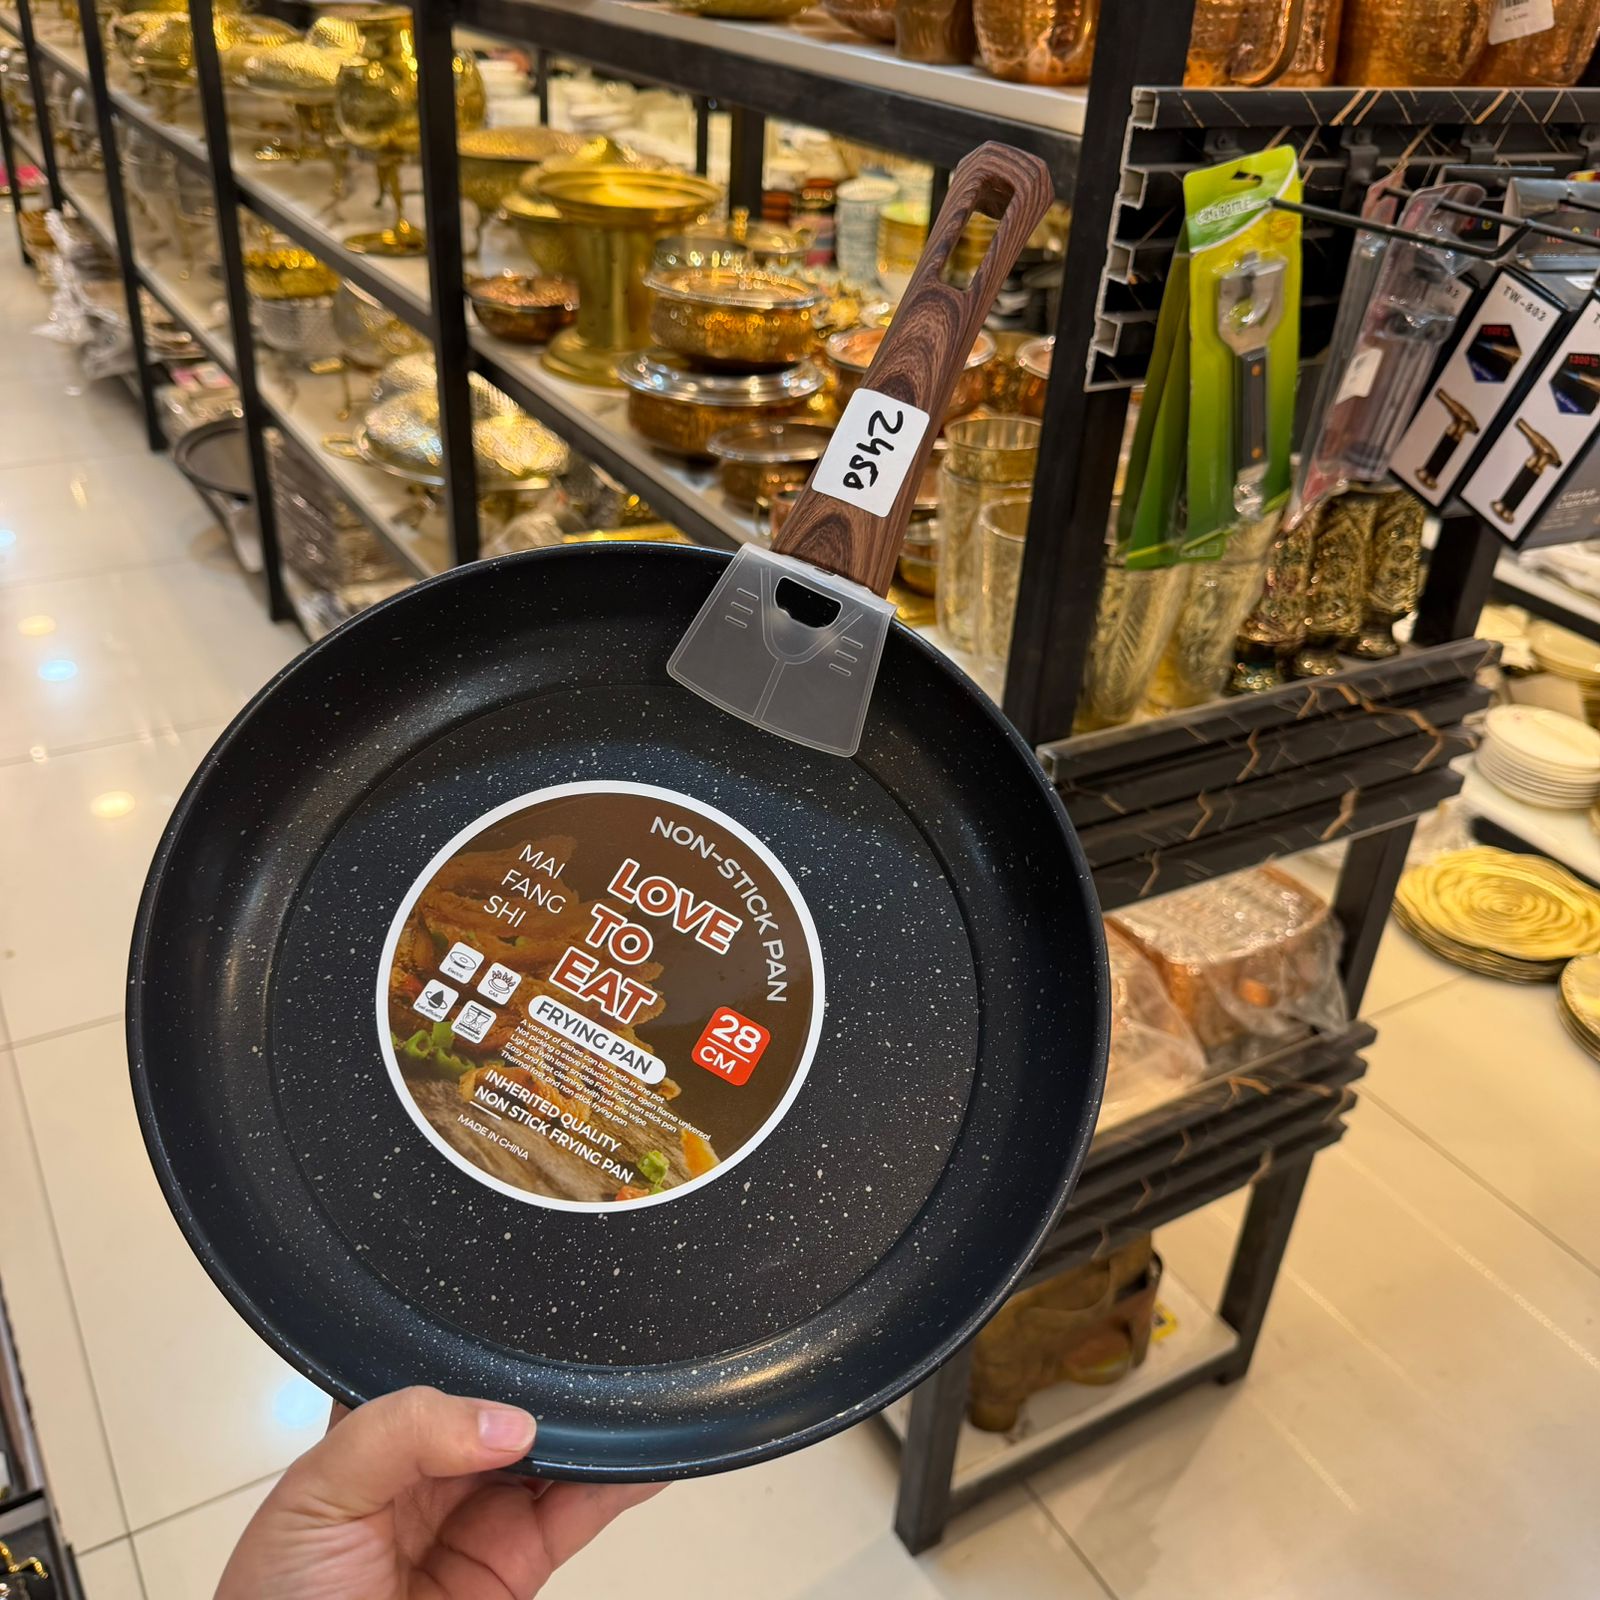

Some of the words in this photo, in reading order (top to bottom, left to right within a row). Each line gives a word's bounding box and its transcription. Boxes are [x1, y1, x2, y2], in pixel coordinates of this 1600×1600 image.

[843, 410, 904, 490] 2450
[501, 869, 566, 913] FANG
[518, 844, 565, 879] MAI
[483, 896, 526, 927] SHI
[586, 903, 653, 965] TO
[607, 858, 743, 955] LOVE
[650, 816, 778, 936] NON-STICK
[762, 940, 787, 1002] PAN
[549, 946, 658, 1024] EAT
[528, 1023, 552, 1042] variety
[561, 1042, 584, 1058] dishes
[584, 1054, 598, 1066] can
[598, 1062, 608, 1072] be
[608, 1066, 630, 1084] made
[629, 1079, 637, 1088] in
[637, 1085, 651, 1096] one
[651, 1092, 665, 1104] pot
[536, 1001, 609, 1050] FRYING
[609, 1041, 653, 1075] PAN
[700, 1046, 737, 1075] CM
[711, 1014, 762, 1054] 28
[485, 1069, 560, 1118] INHERITED
[560, 1113, 622, 1153] QUALITY
[501, 1050, 530, 1071] Thermal
[530, 1066, 546, 1079] fast
[545, 1076, 561, 1088] and
[560, 1084, 574, 1096] non
[574, 1092, 592, 1106] stick
[592, 1101, 613, 1119] frying
[612, 1114, 628, 1126] pan
[505, 1042, 524, 1056] Easy
[524, 1052, 539, 1064] and
[538, 1060, 554, 1073] fast
[554, 1070, 584, 1090] cleaning
[584, 1086, 601, 1099] with
[599, 1097, 614, 1108] just
[614, 1104, 629, 1116] one
[628, 1112, 647, 1126] wipe
[510, 1034, 530, 1049] Light
[529, 1045, 539, 1054] oil
[539, 1049, 555, 1063] with
[555, 1059, 570, 1071] less
[570, 1068, 595, 1085] smoke
[594, 1081, 614, 1096] Fried
[613, 1091, 632, 1106] food
[630, 1102, 645, 1115] non
[644, 1110, 662, 1124] stick
[661, 1121, 677, 1133] pan
[515, 1026, 529, 1037] Not
[529, 1034, 555, 1053] picking
[561, 1052, 581, 1067] stove
[581, 1062, 613, 1085] induction
[613, 1080, 639, 1099] cooker
[638, 1097, 657, 1111] open
[678, 1119, 711, 1141] universal
[457, 1114, 487, 1136] MADE
[487, 1130, 500, 1143] IN
[499, 1138, 529, 1160] CHINA
[474, 1086, 510, 1112] NON
[508, 1105, 552, 1136] STICK
[549, 1128, 602, 1166] FRYING
[601, 1158, 634, 1184] PAN
